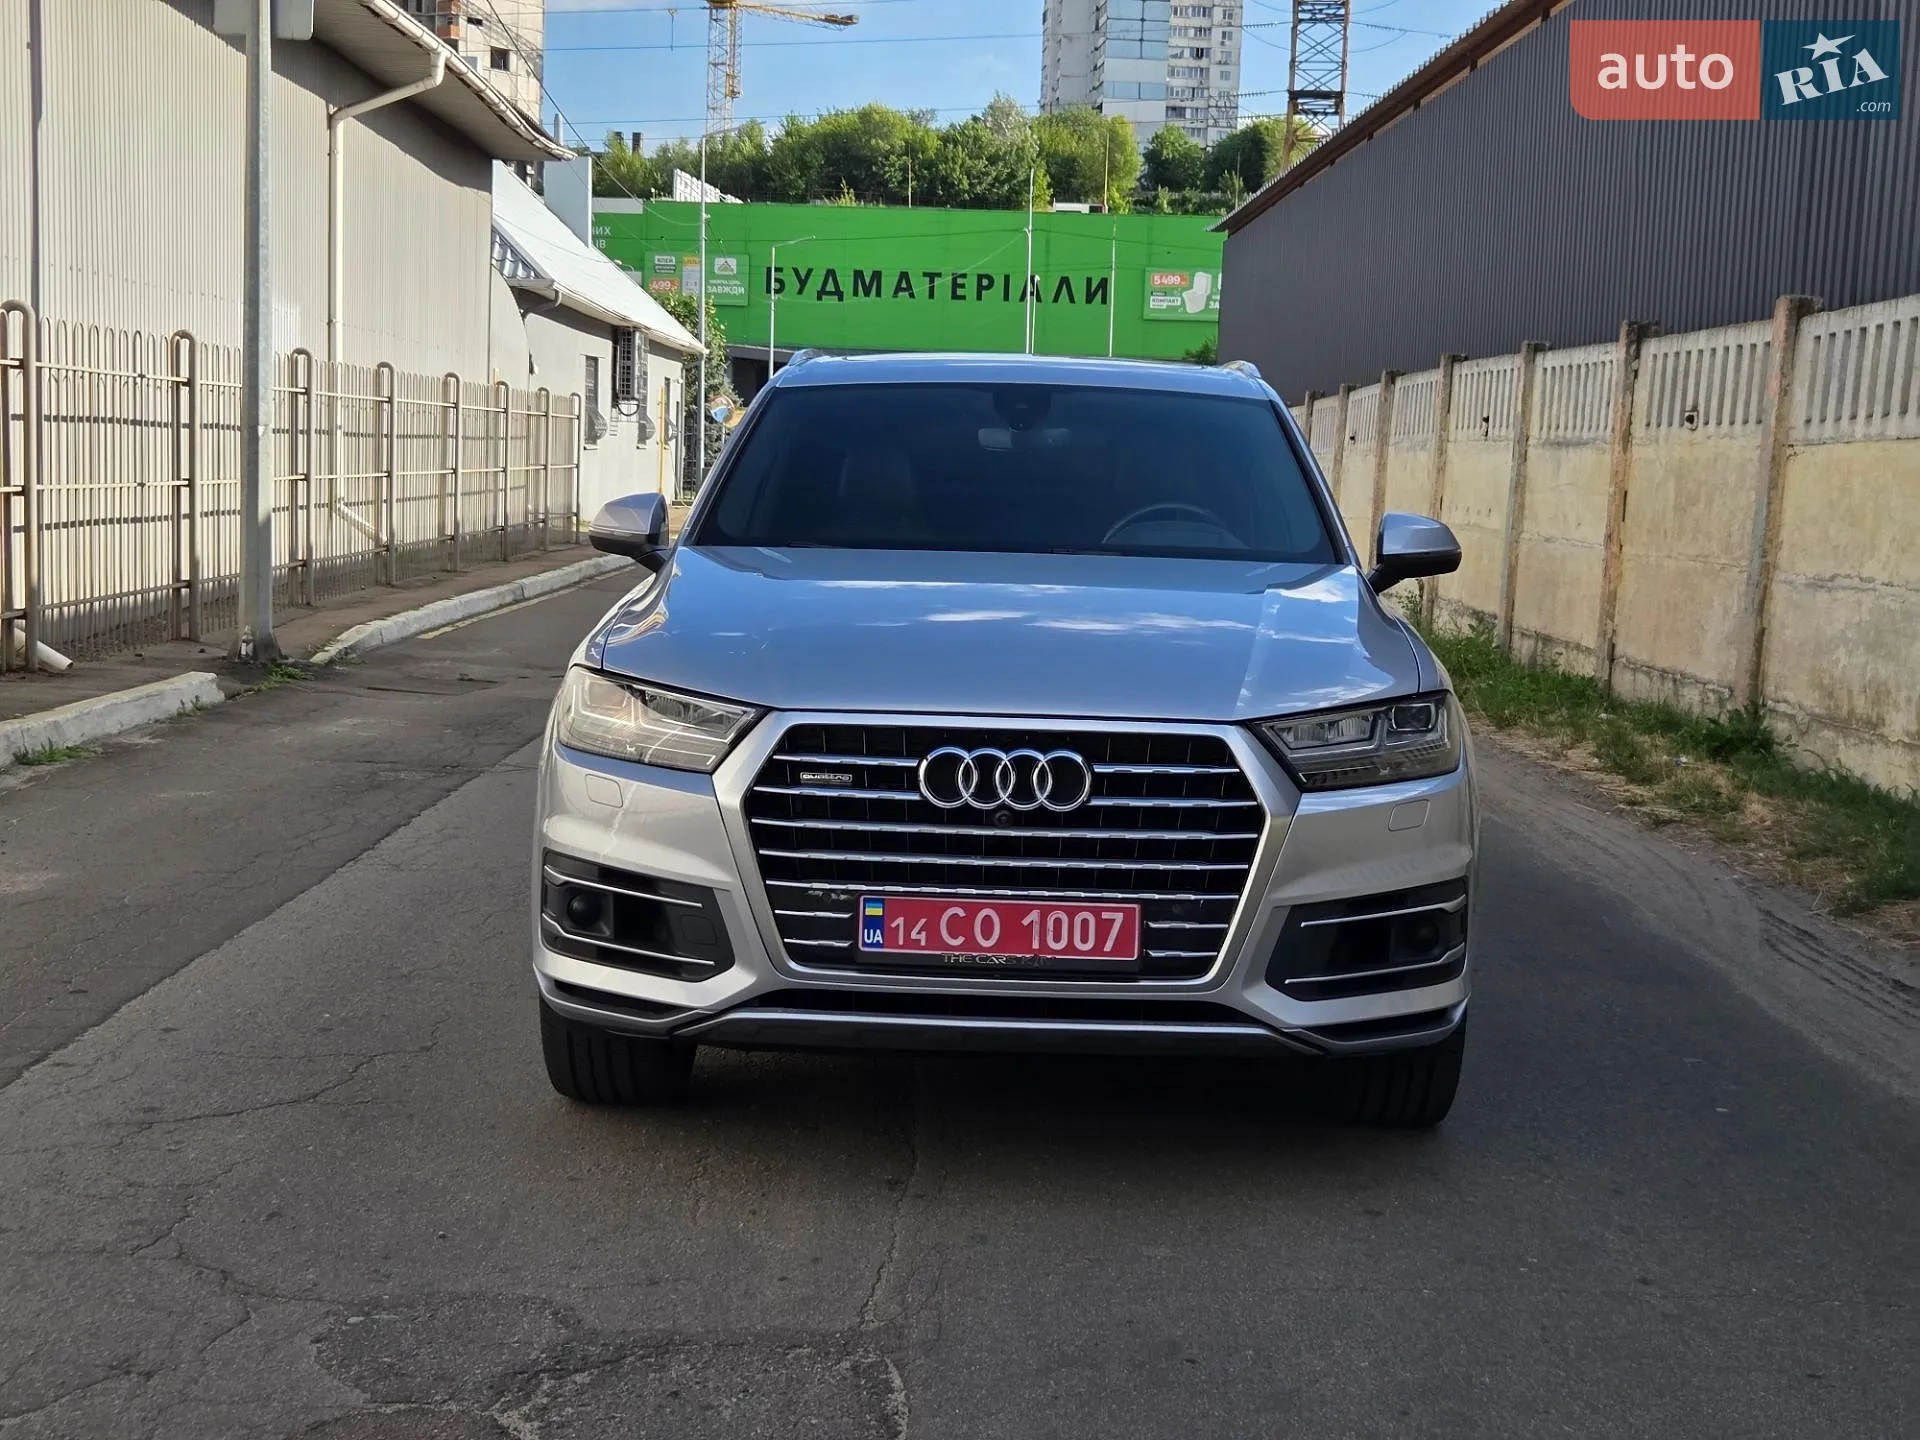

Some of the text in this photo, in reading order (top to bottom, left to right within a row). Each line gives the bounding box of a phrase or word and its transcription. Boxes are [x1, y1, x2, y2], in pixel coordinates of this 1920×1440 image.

[765, 266, 1109, 305] БУДМАТЕРІАЛИ
[864, 928, 883, 944] UA
[890, 906, 1124, 952] 14 CO 1007
